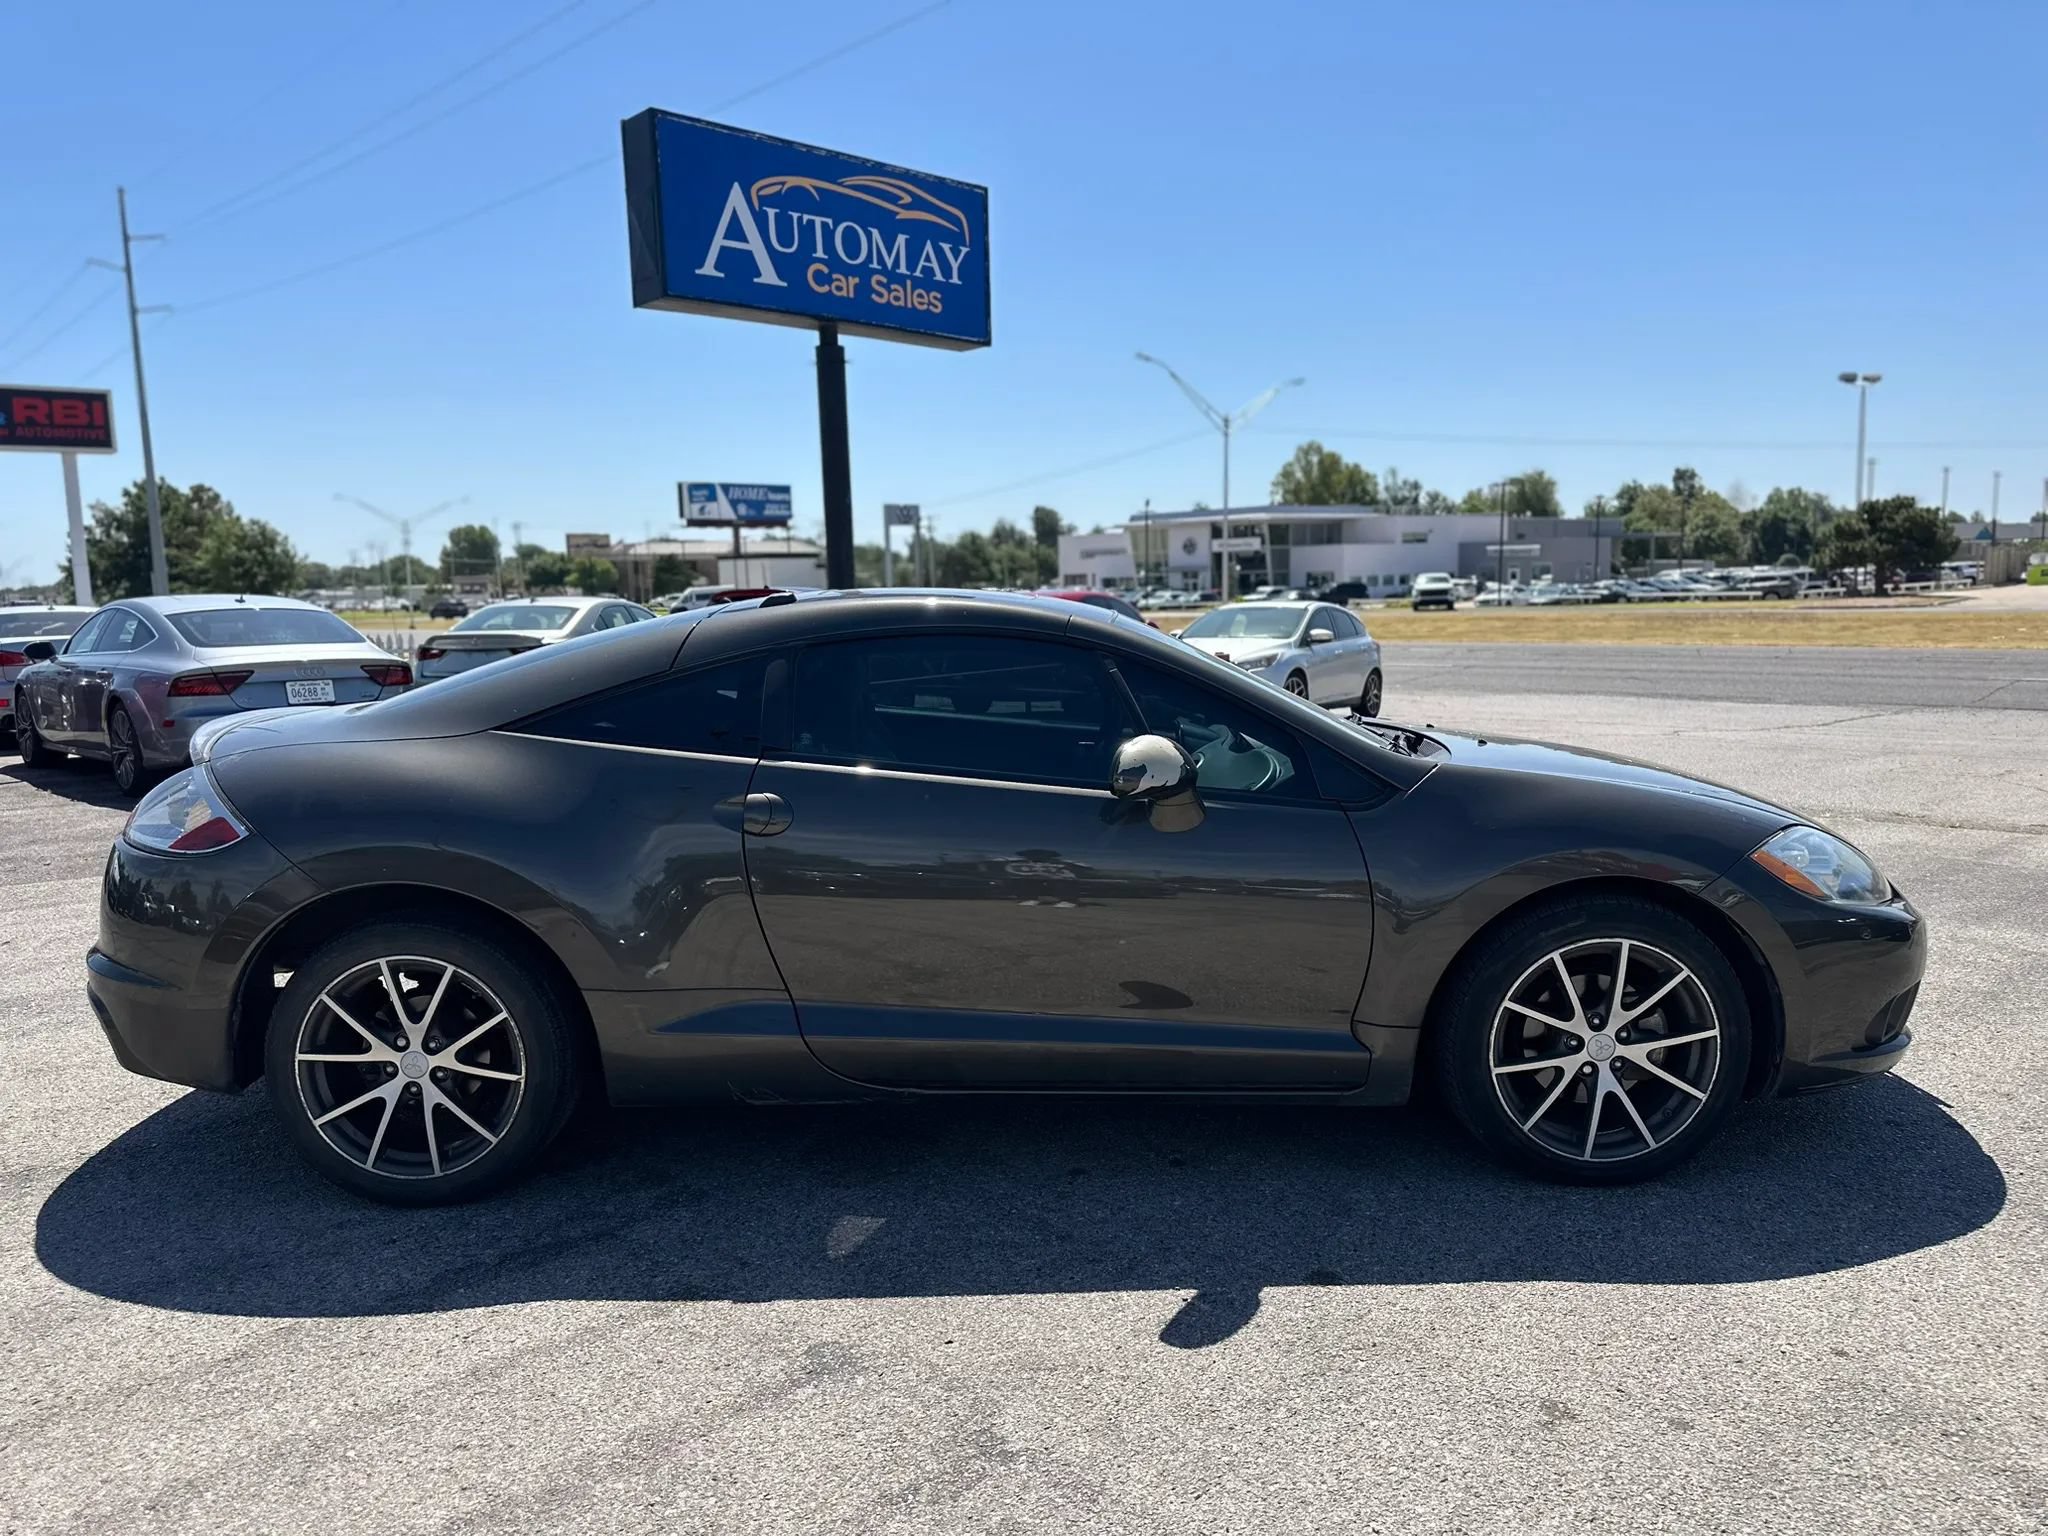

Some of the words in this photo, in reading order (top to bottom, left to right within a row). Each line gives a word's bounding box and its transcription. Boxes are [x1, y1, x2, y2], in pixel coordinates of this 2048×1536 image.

[694, 181, 971, 288] AUTOMAY
[806, 262, 860, 299] Car
[870, 273, 944, 314] Sales
[12, 396, 106, 427] RBI
[291, 687, 319, 698] 06288
